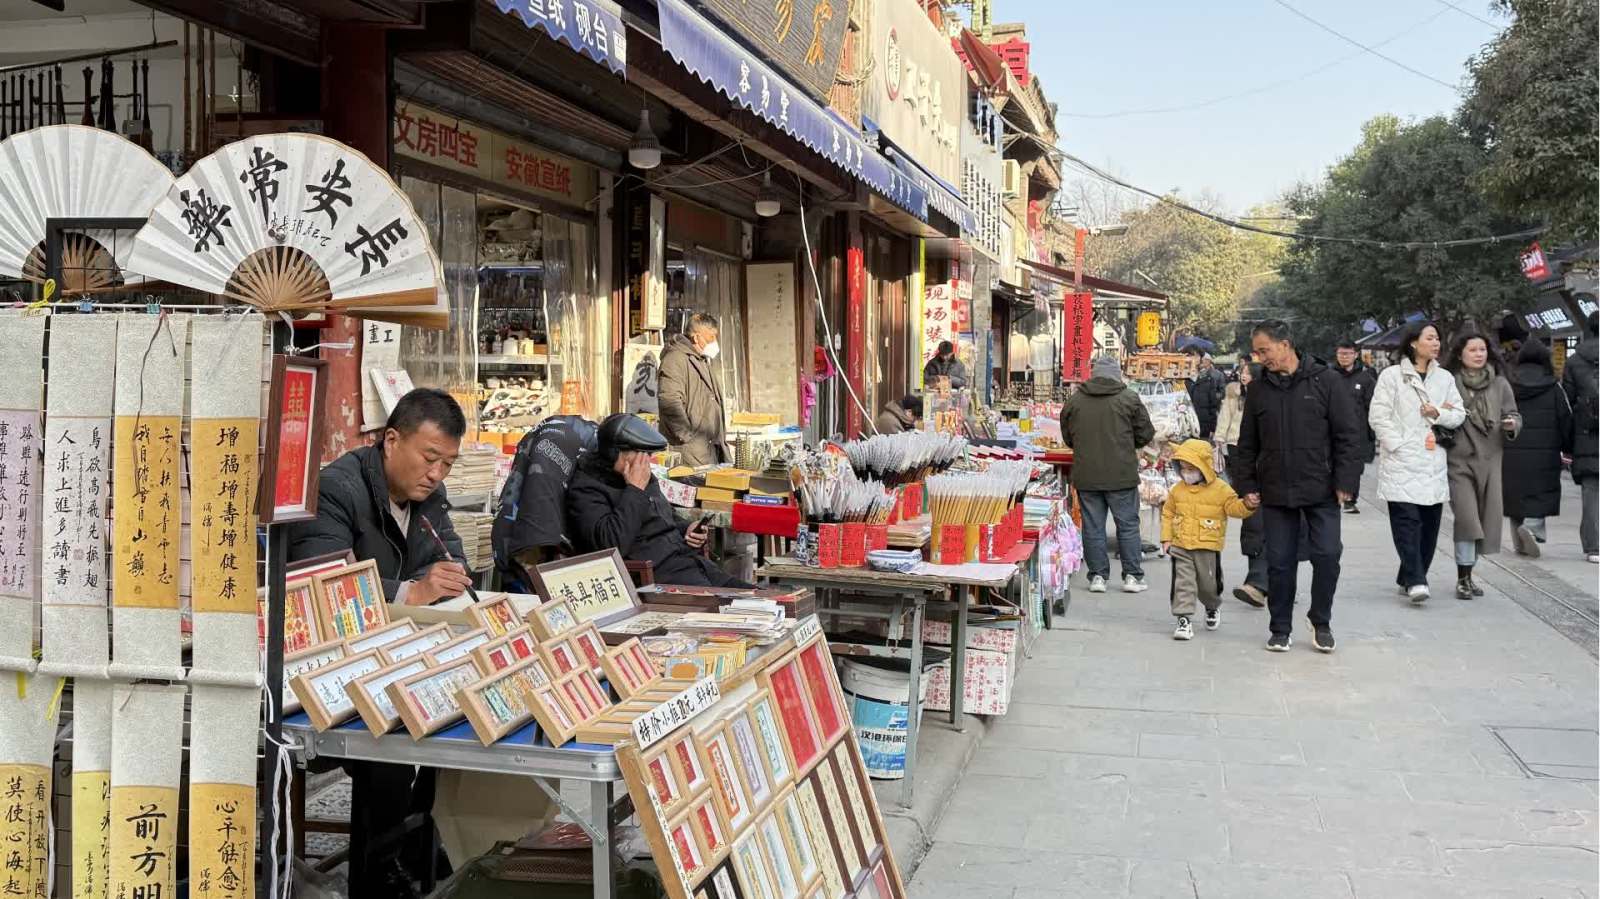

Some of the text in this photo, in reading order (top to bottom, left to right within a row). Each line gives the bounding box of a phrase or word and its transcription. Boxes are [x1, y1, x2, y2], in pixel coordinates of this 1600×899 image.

[573, 1, 609, 57] 砚台
[394, 108, 479, 169] 文房四宝
[505, 146, 572, 198] 安徽宣纸
[2, 776, 26, 896] 莫使心海起
[215, 799, 242, 899] 心平能愈
